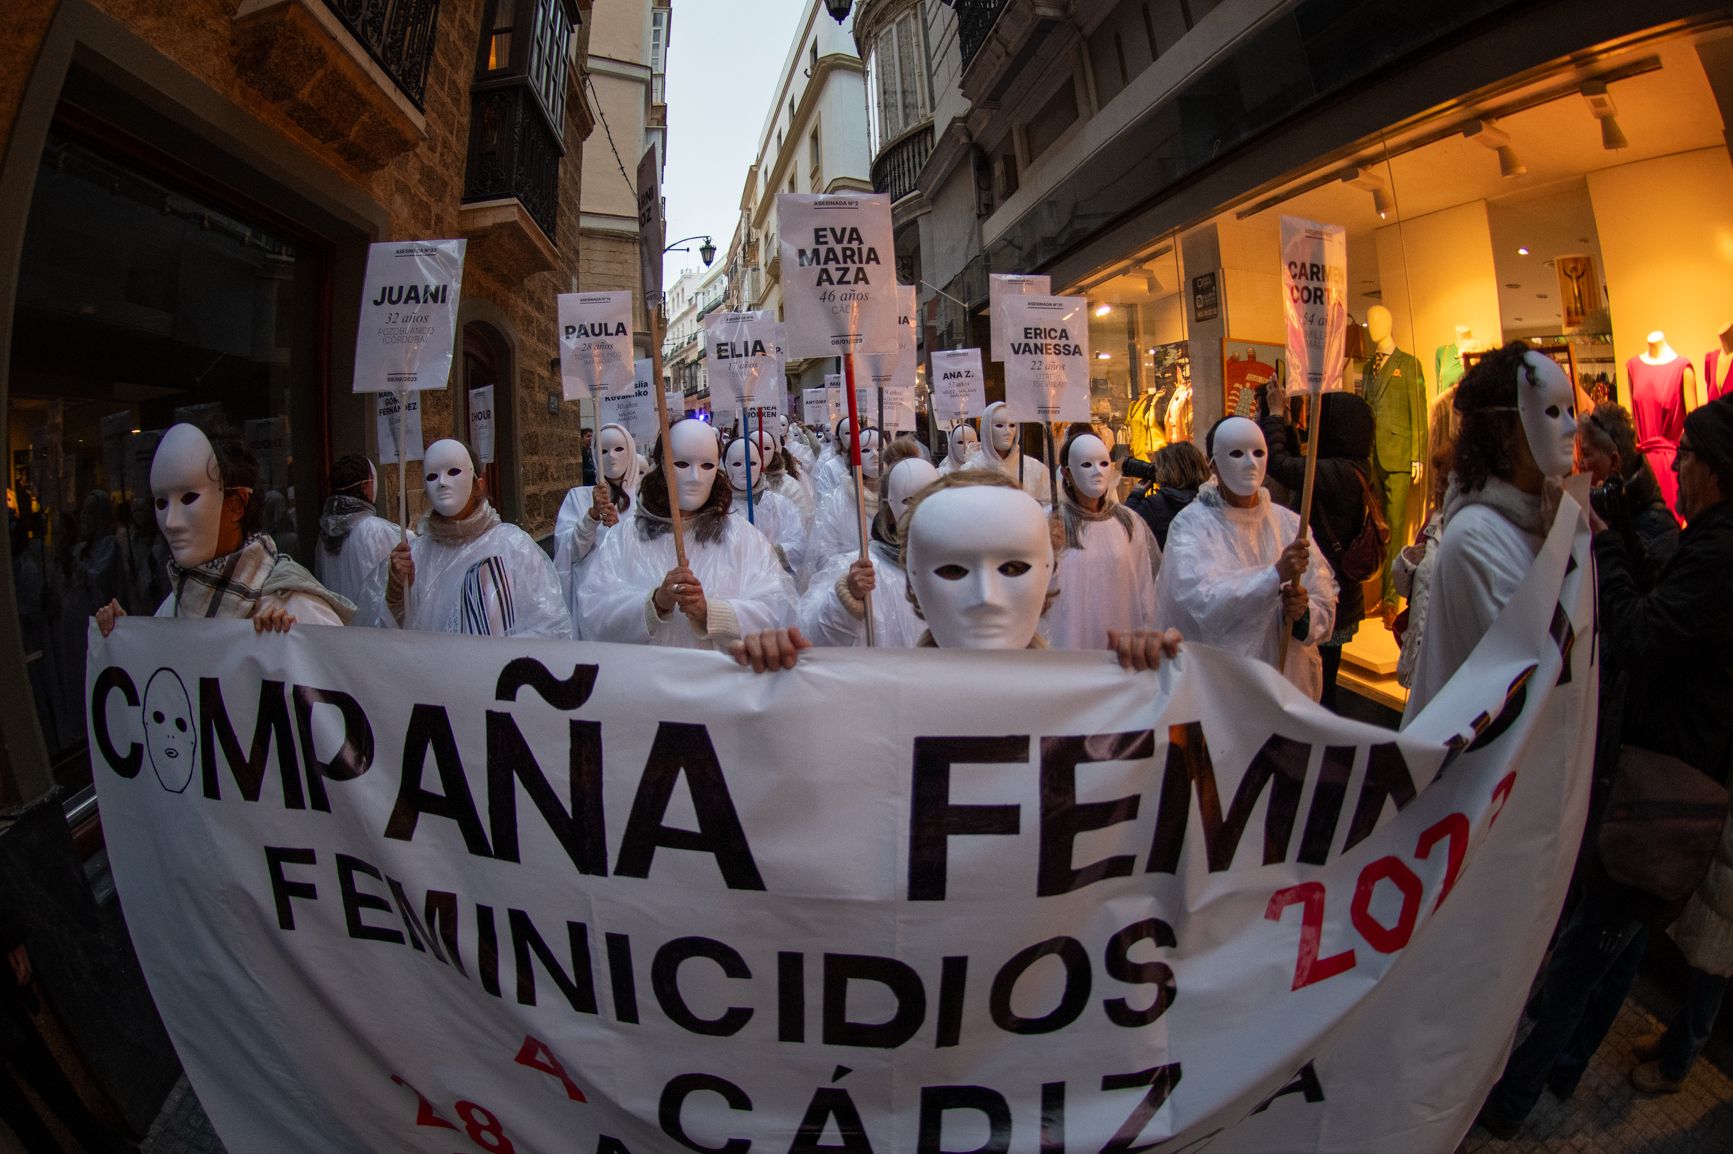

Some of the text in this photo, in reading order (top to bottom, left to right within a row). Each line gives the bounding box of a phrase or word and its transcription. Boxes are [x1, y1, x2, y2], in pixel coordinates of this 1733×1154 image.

[813, 227, 864, 246] EVA
[798, 243, 881, 267] MARÍA
[816, 267, 870, 287] AZA
[373, 284, 448, 306] JUANI
[819, 289, 870, 303] 46 años
[1290, 285, 1344, 306] CORTS
[385, 311, 429, 324] 32 años
[378, 326, 434, 336] POZOBLANCO
[564, 322, 628, 340] PAULA
[1023, 327, 1069, 341] ERICA
[581, 342, 592, 352] 28
[716, 339, 768, 359] ELIA
[1010, 342, 1083, 357] VANESSA
[1030, 361, 1065, 371] 22 años
[943, 371, 963, 380] ANA
[264, 846, 1178, 1048] FEMINICIDIOS
[658, 1063, 1182, 1154] CÁDIZ
